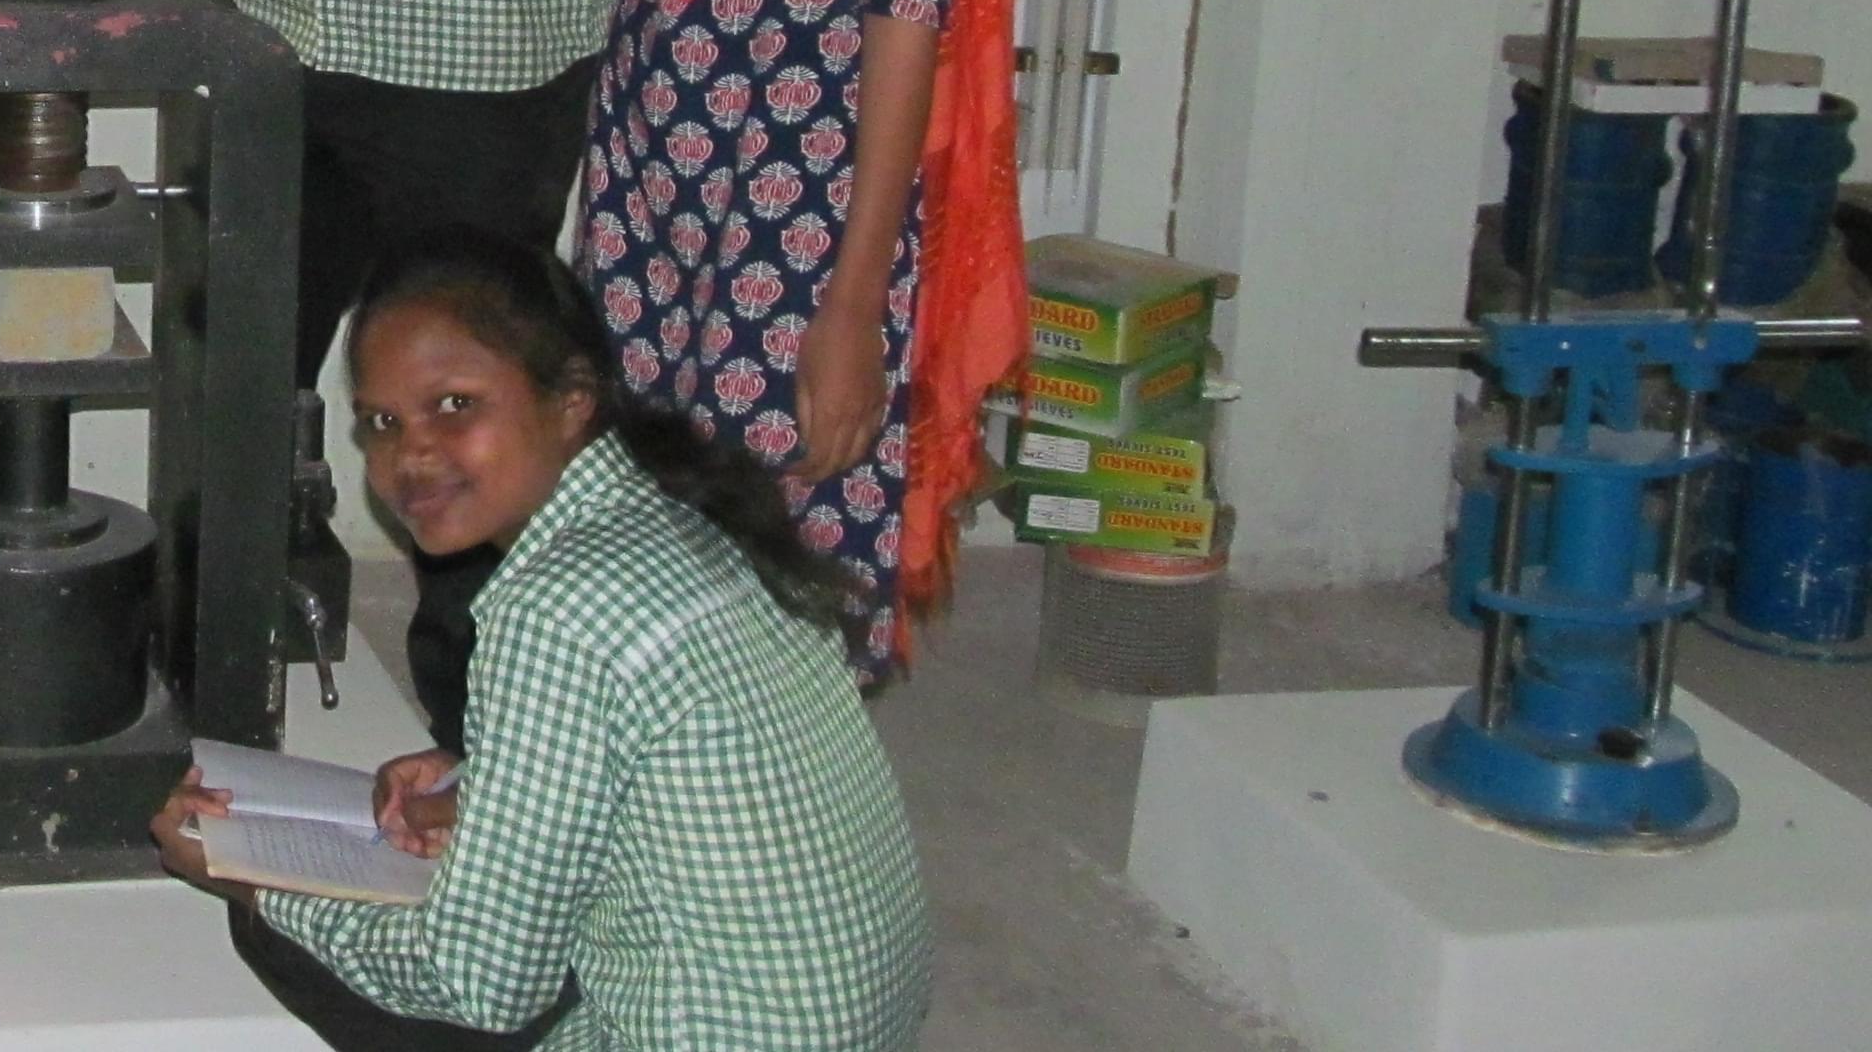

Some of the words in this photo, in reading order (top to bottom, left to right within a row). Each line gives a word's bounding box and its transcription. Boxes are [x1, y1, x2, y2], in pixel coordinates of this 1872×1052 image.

[1035, 329, 1081, 352] IEVES
[1096, 454, 1194, 478] STANDARD
[1109, 513, 1203, 533] STANDARD
